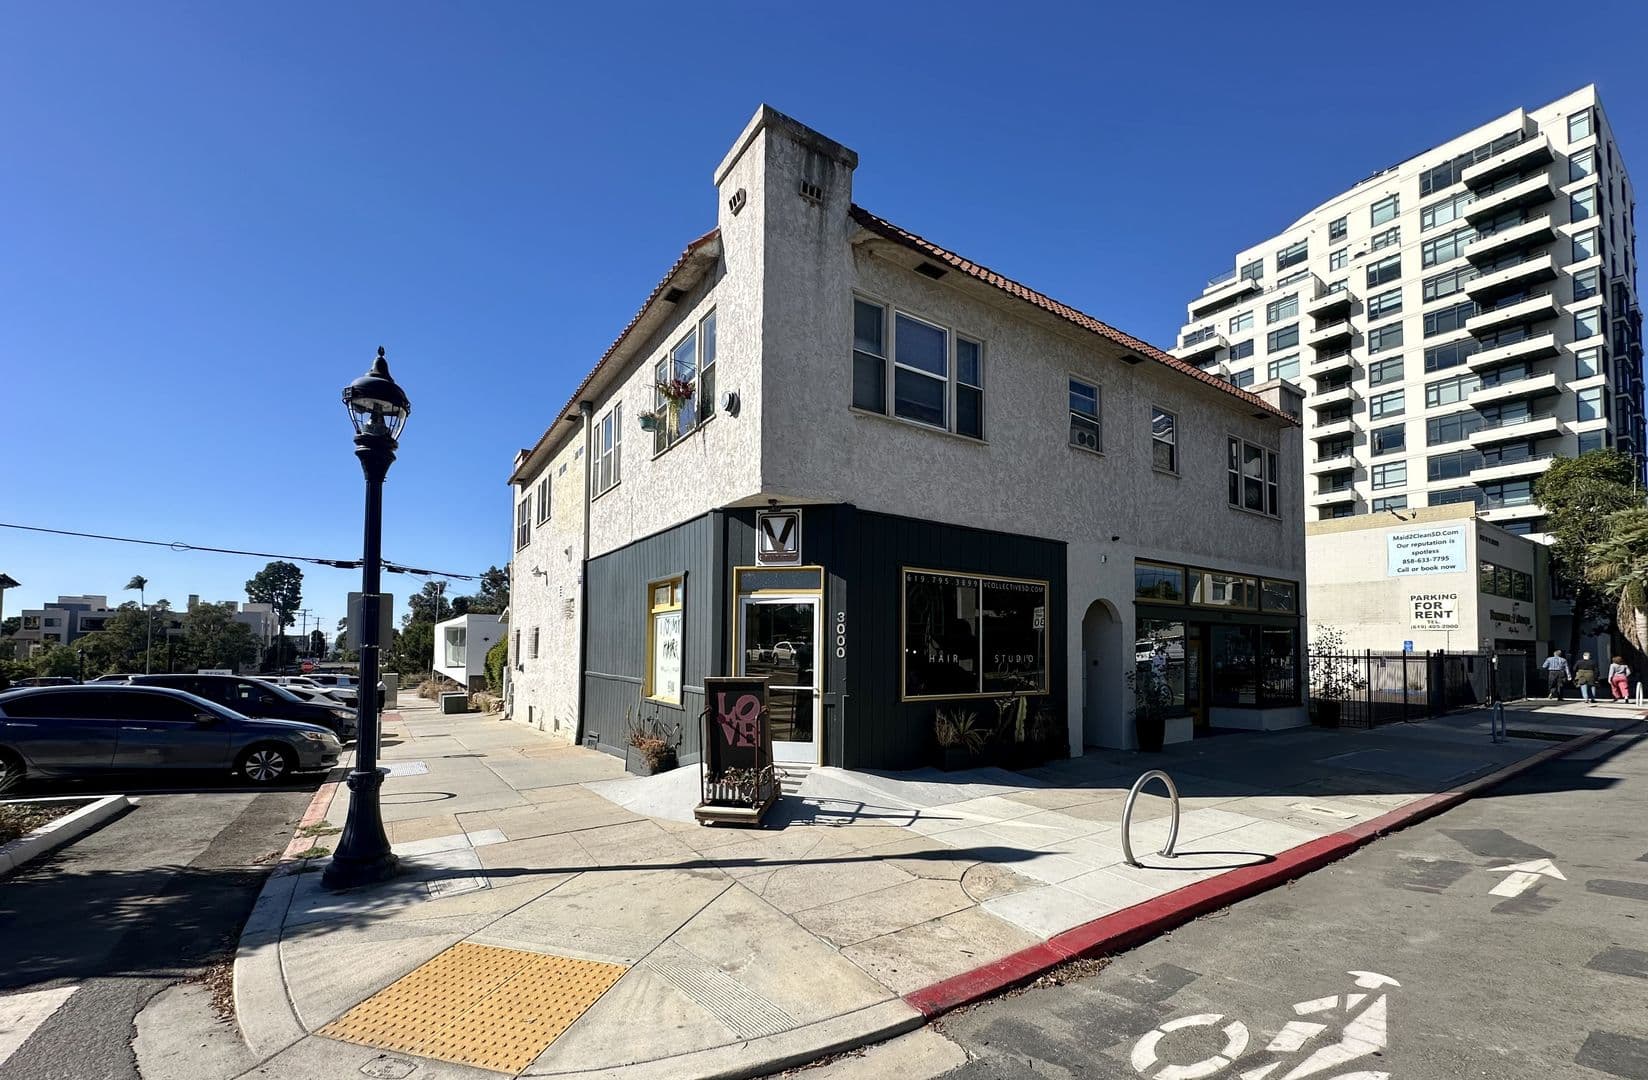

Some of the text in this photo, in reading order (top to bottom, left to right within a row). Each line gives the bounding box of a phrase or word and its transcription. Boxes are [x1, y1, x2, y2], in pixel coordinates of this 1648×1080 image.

[762, 518, 795, 551] V
[1411, 540, 1447, 548] reputation
[1410, 593, 1457, 601] PARKING
[1415, 601, 1443, 610] FOR
[1415, 610, 1453, 619] RENT
[836, 611, 845, 658] 3000
[928, 654, 1034, 664] HAIR STUDIO
